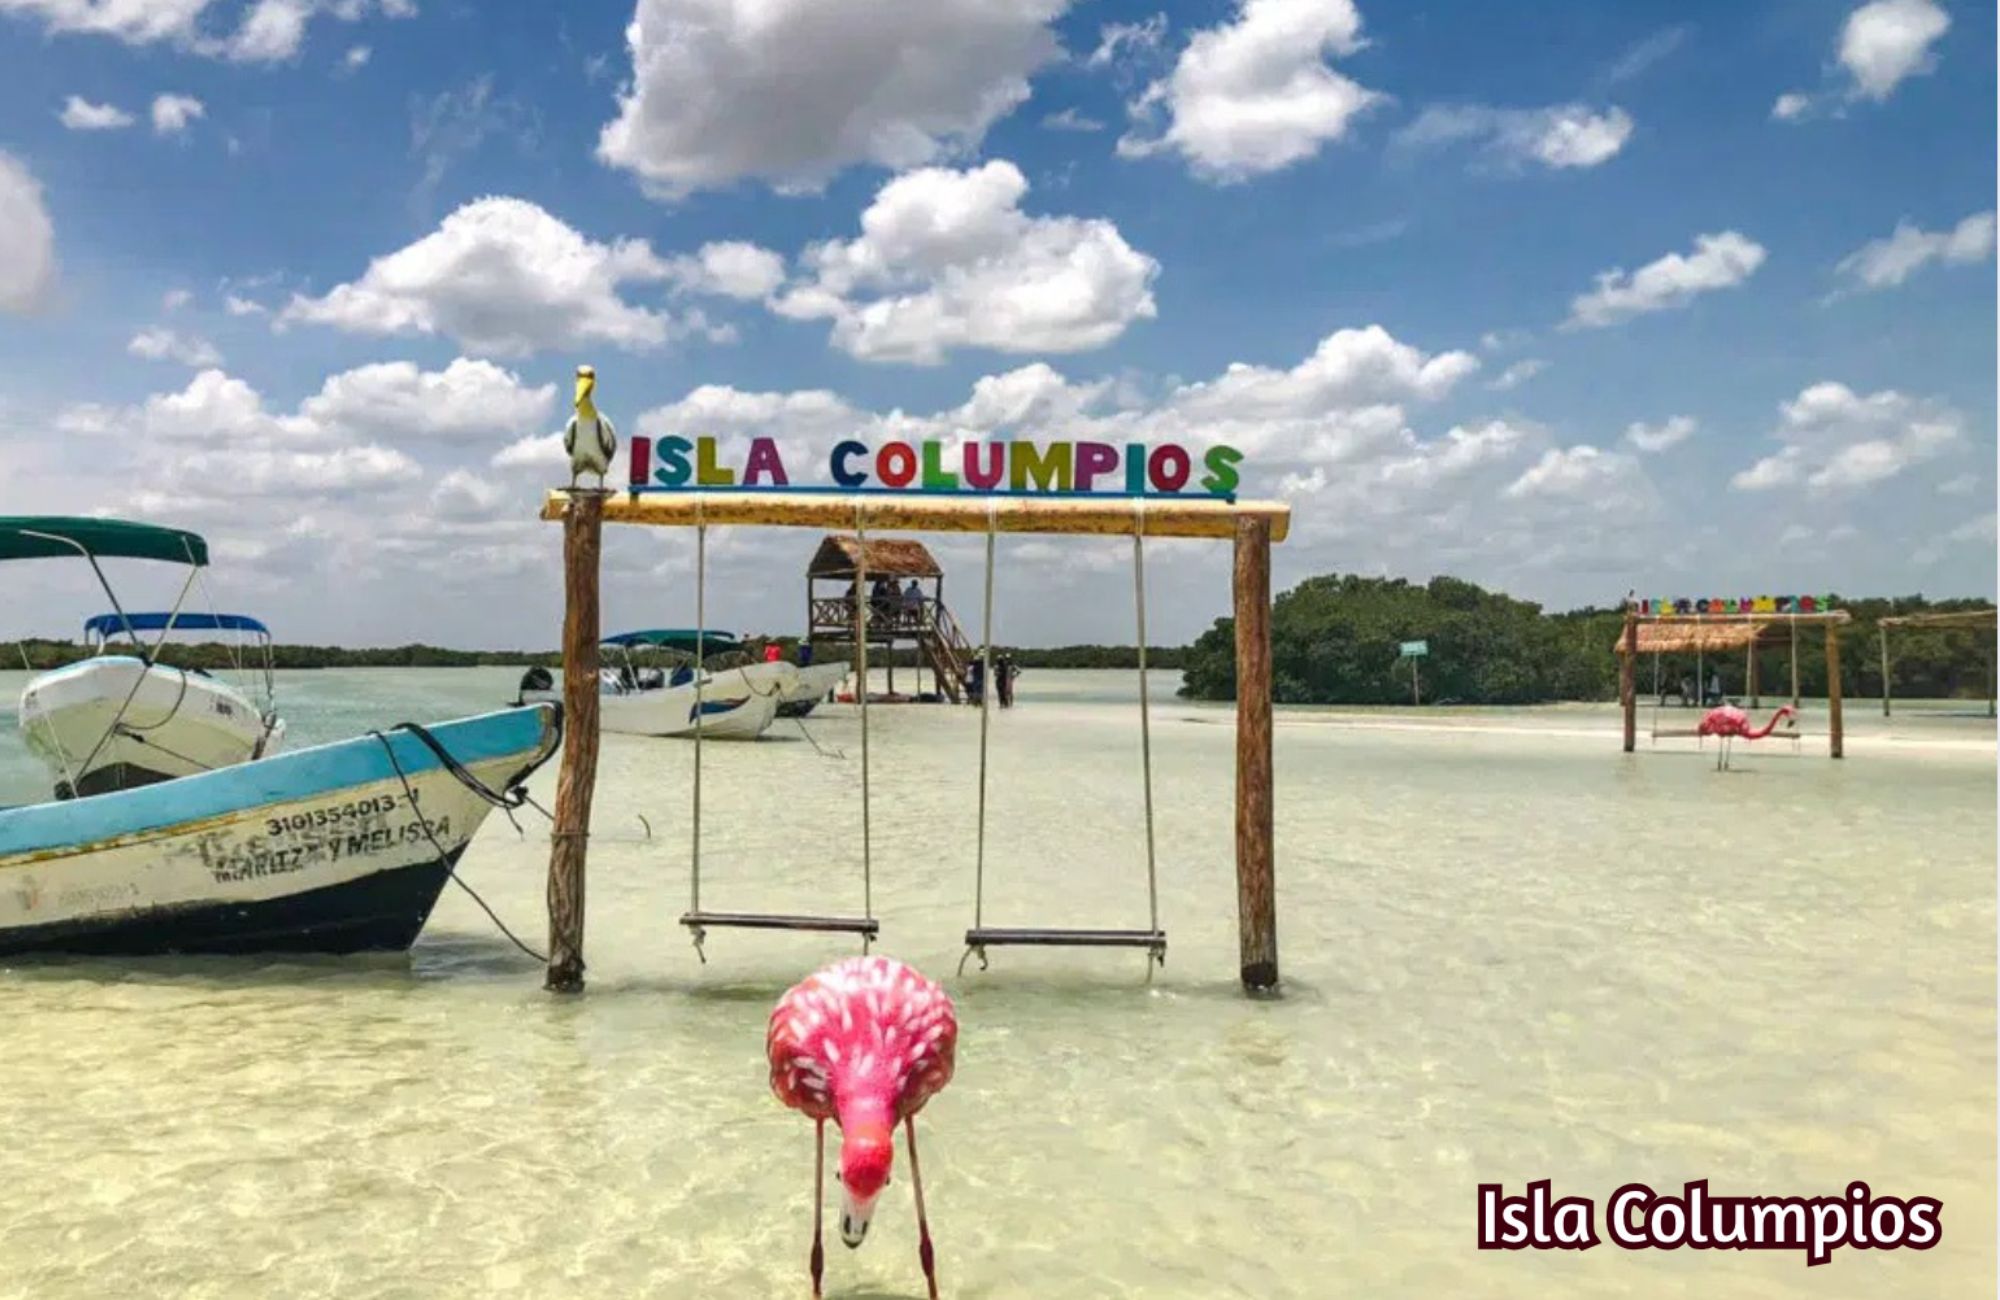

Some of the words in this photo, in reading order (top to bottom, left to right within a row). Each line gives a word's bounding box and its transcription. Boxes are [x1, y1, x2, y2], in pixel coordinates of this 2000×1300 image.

[630, 436, 788, 487] ISLA
[831, 441, 1243, 494] COLUMPIOS
[347, 815, 451, 857] MELISSA
